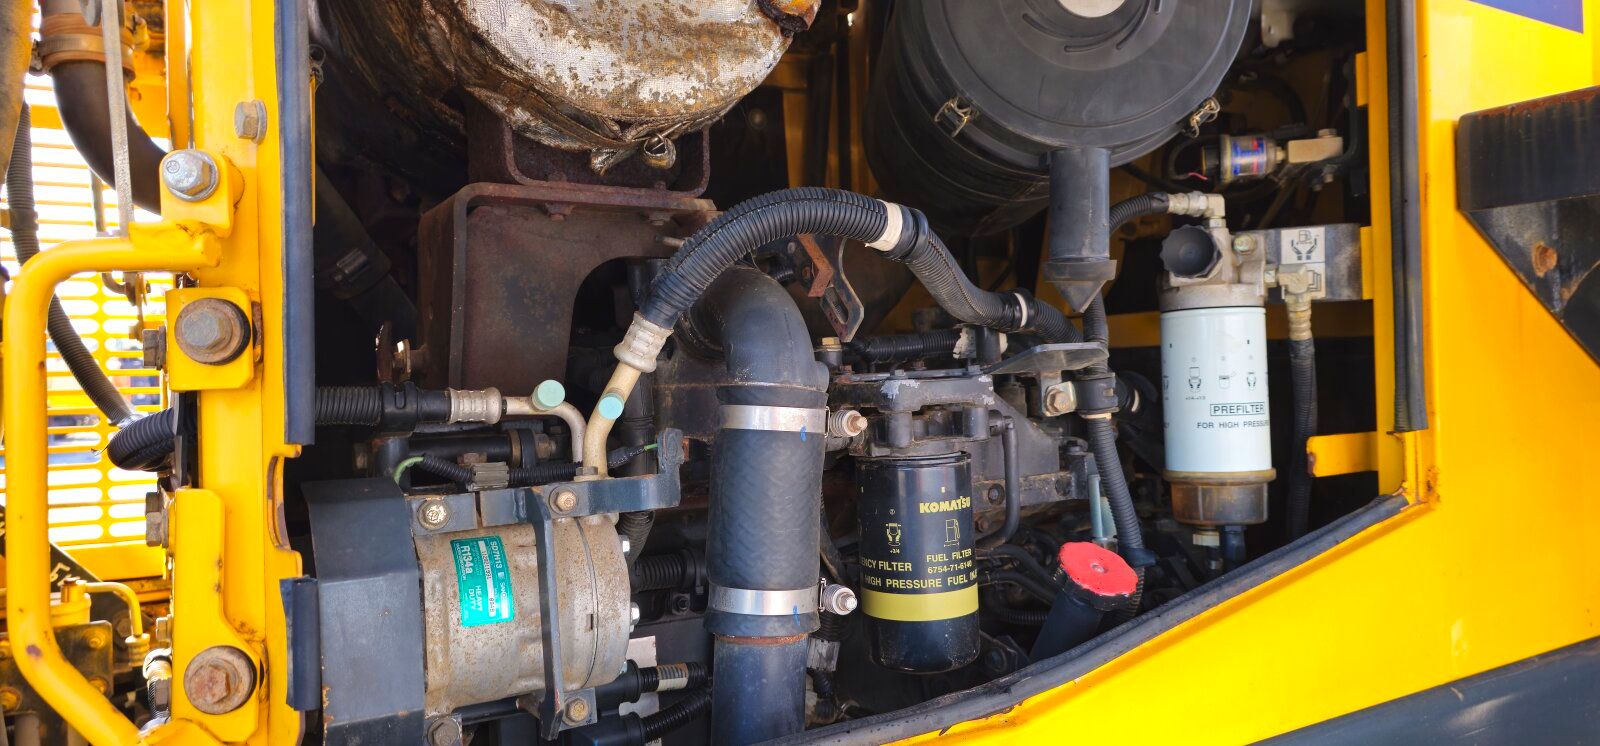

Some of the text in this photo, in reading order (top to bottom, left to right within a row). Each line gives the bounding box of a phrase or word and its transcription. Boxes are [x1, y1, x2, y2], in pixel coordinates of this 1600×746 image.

[1213, 404, 1264, 414] PREFILTER
[920, 496, 970, 513] KOMATSU
[461, 545, 473, 574] R134a
[490, 541, 502, 568] SD7H13
[927, 549, 971, 562] FUEL FILTER
[879, 561, 912, 571] FILTER
[886, 579, 942, 588] PRESSURE
[947, 574, 968, 586] FUEL
[469, 588, 477, 610] DUTY
[475, 585, 483, 611] HEAVY
